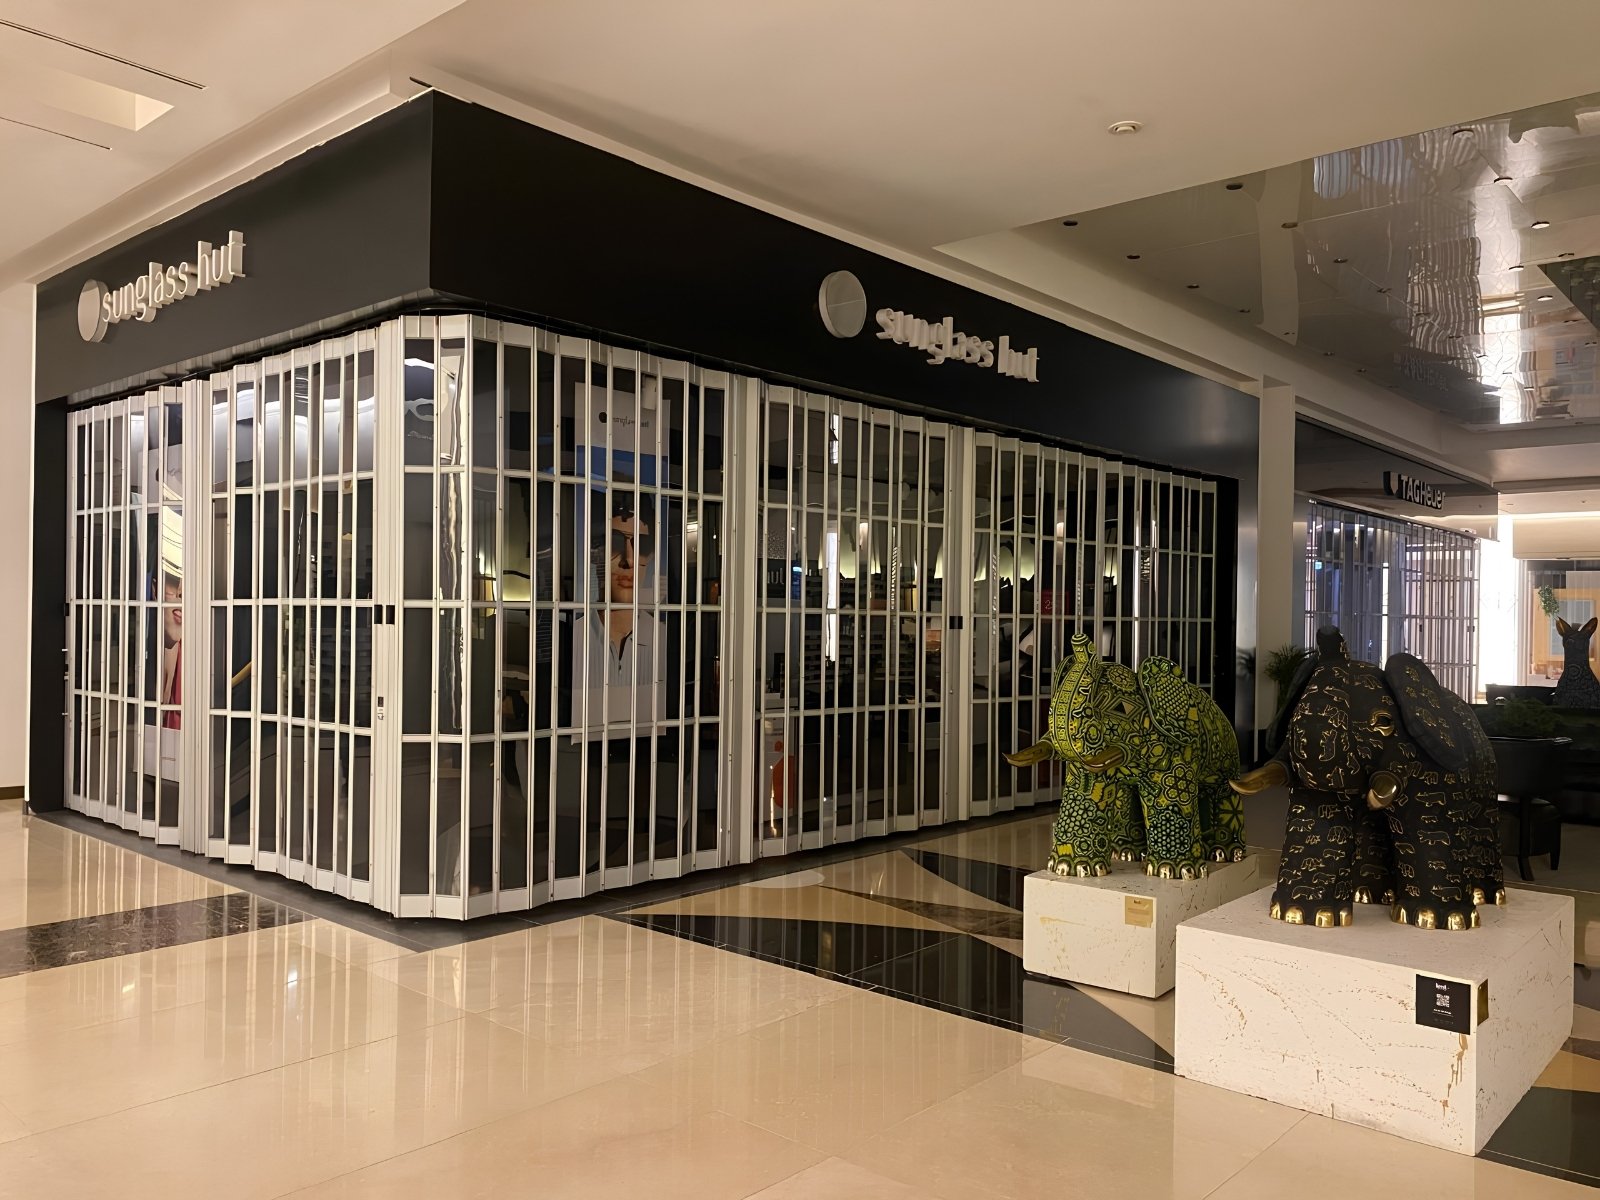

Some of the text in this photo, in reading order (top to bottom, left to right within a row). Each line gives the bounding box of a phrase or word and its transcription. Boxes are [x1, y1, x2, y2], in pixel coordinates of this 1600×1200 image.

[102, 230, 247, 323] sunglass hut
[875, 307, 1040, 383] sunglass hut
